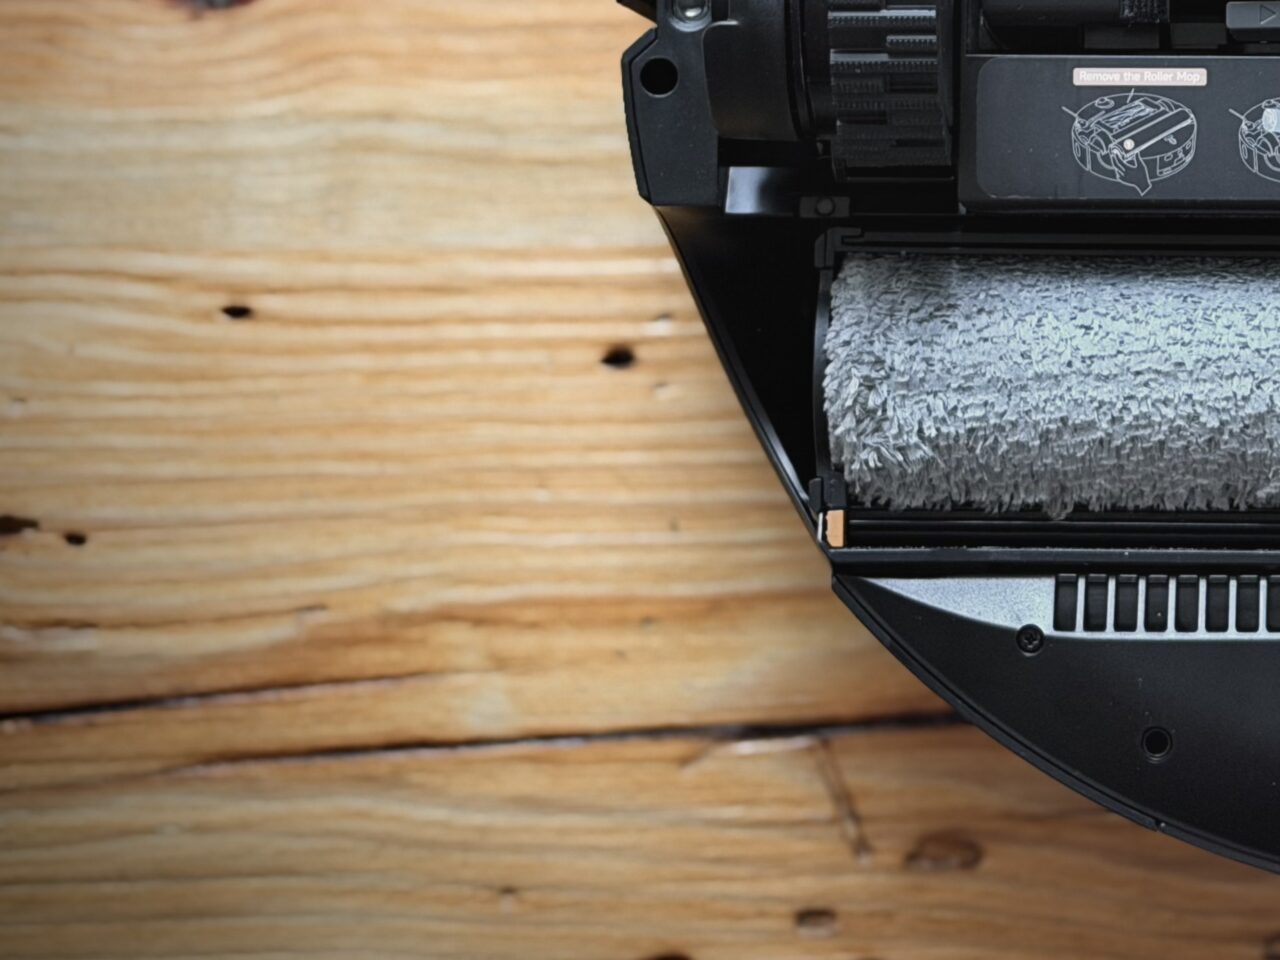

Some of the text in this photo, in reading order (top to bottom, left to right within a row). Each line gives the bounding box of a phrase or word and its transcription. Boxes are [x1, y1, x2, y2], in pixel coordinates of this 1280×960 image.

[1079, 70, 1200, 85] Remove the Roller Mop
